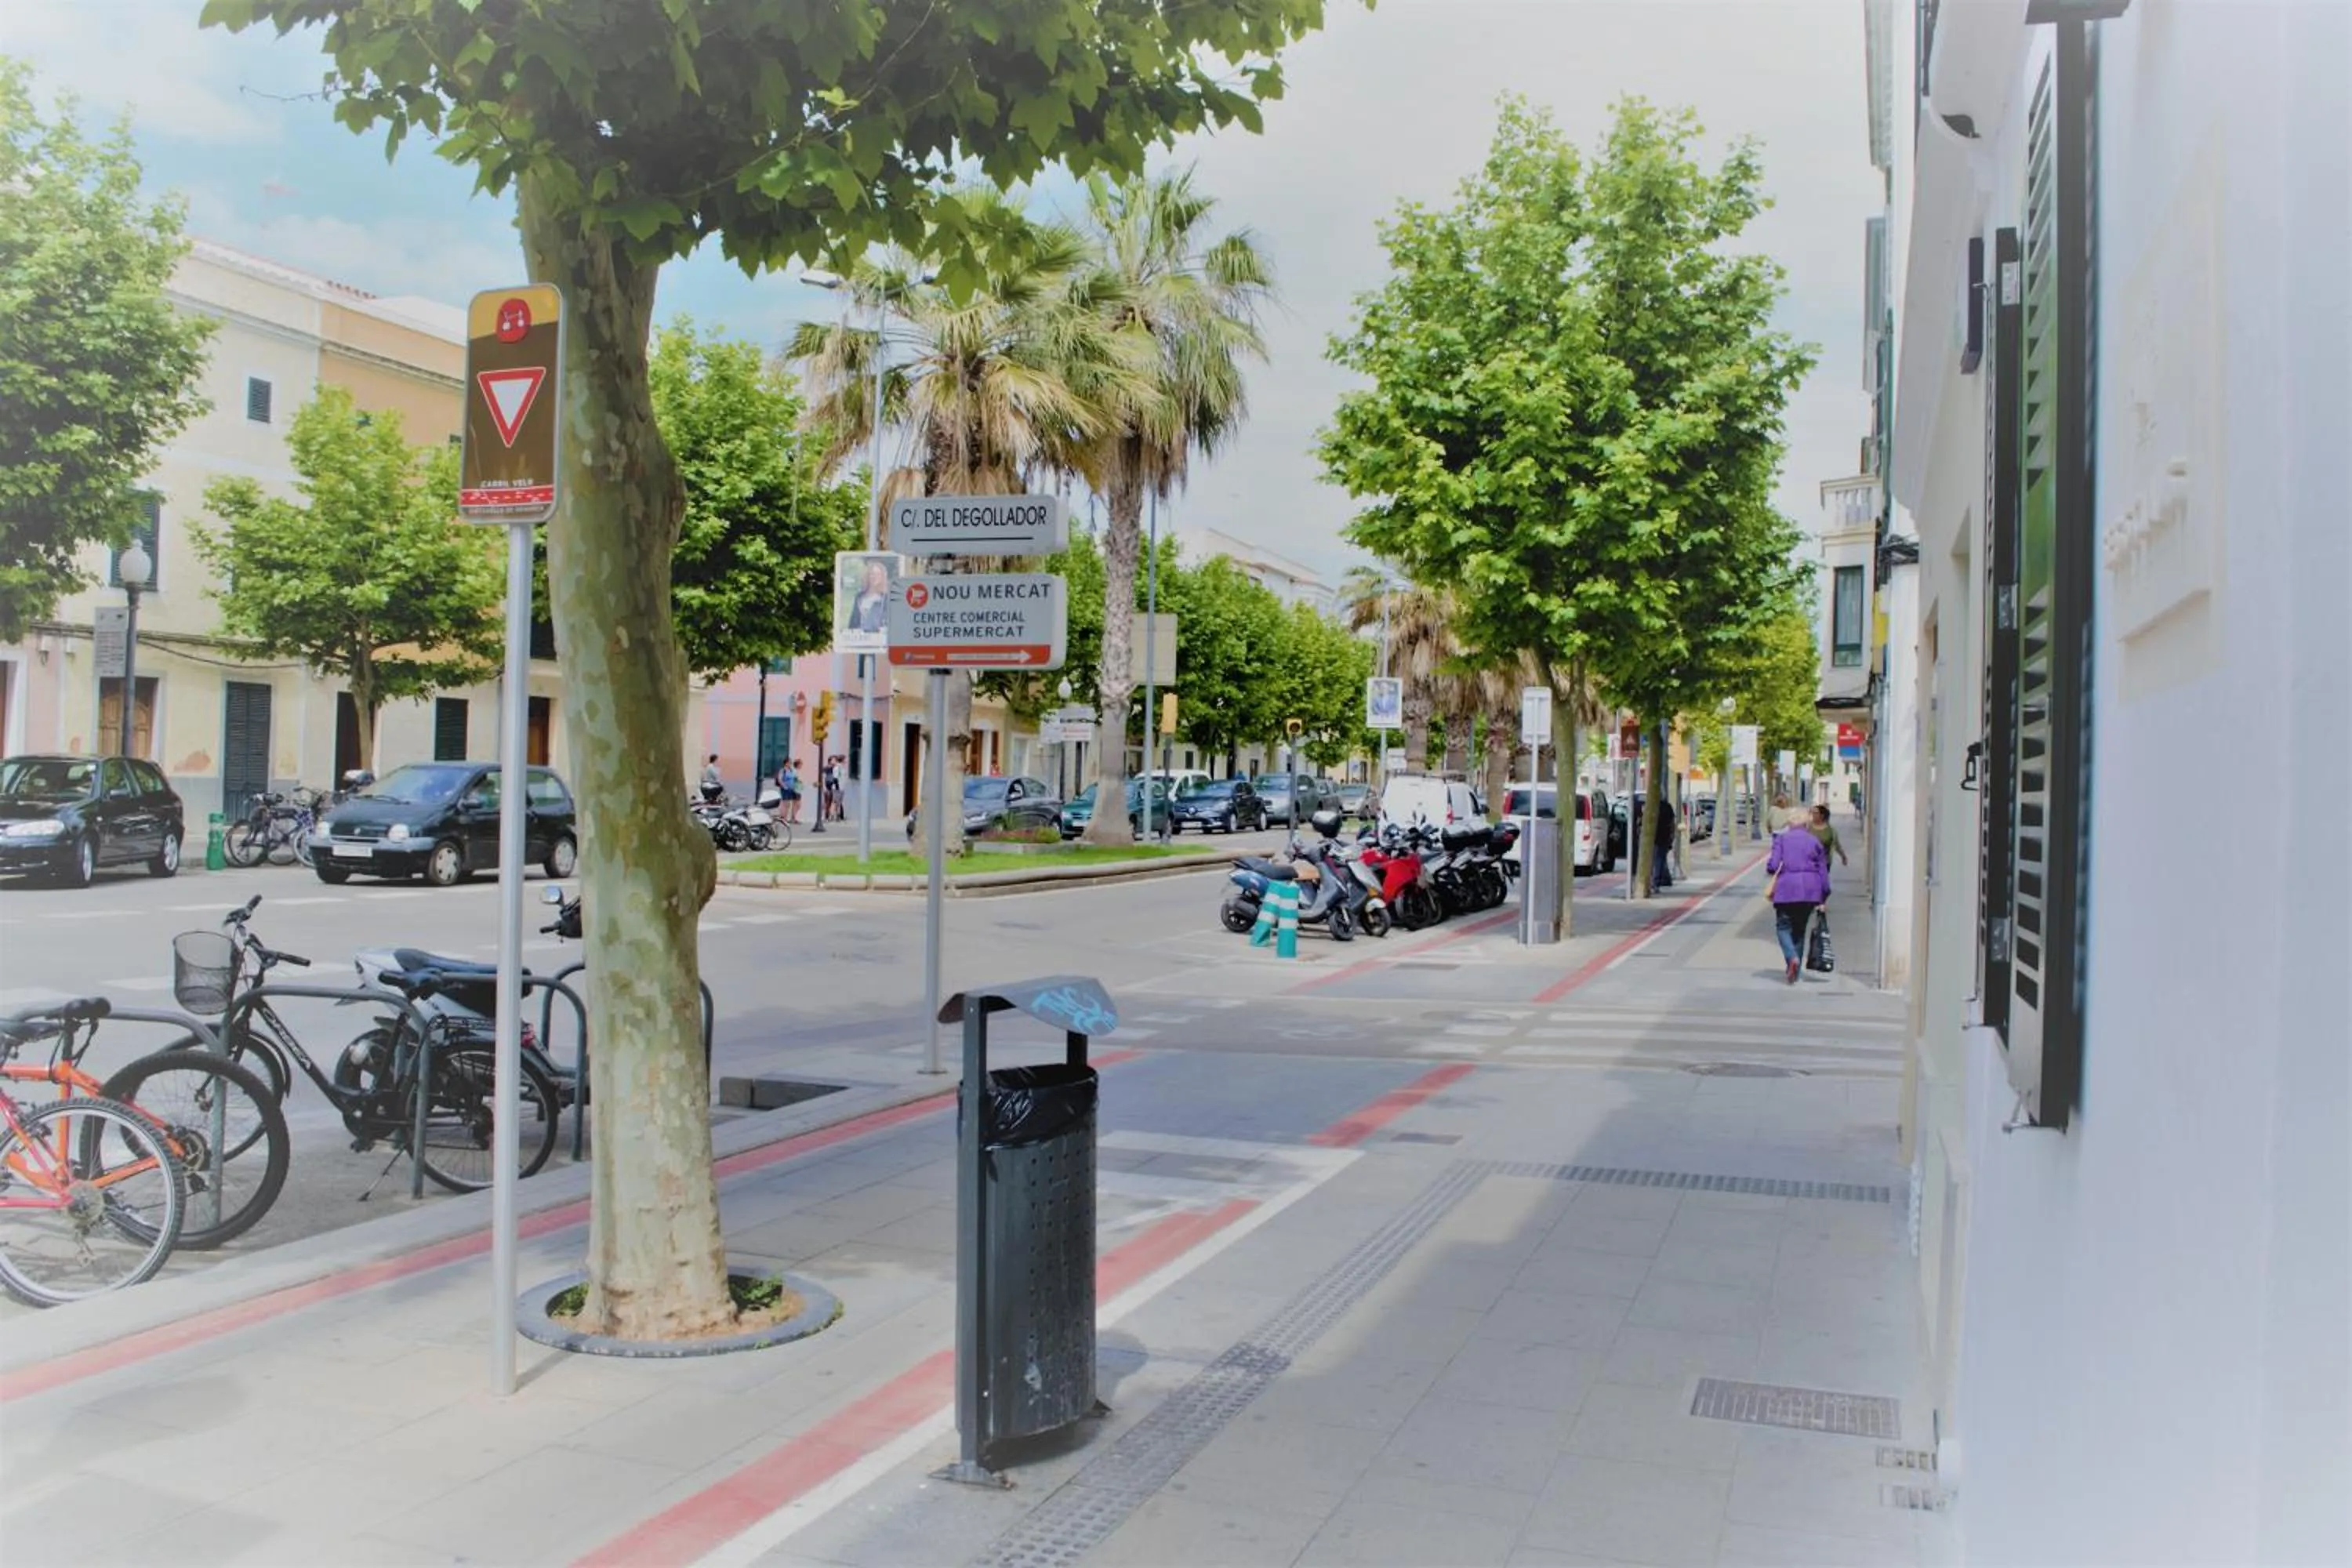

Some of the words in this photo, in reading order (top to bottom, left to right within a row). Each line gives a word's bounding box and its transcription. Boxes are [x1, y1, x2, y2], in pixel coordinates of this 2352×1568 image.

[924, 508, 947, 528] DEL
[953, 506, 1047, 528] DEGOLLADOR
[932, 585, 971, 601] NOU
[977, 583, 1051, 599] MERCAT
[913, 612, 956, 625] CENTRE
[960, 611, 1025, 623] COMERCIAL
[913, 626, 1025, 639] SUPERMERCAT
